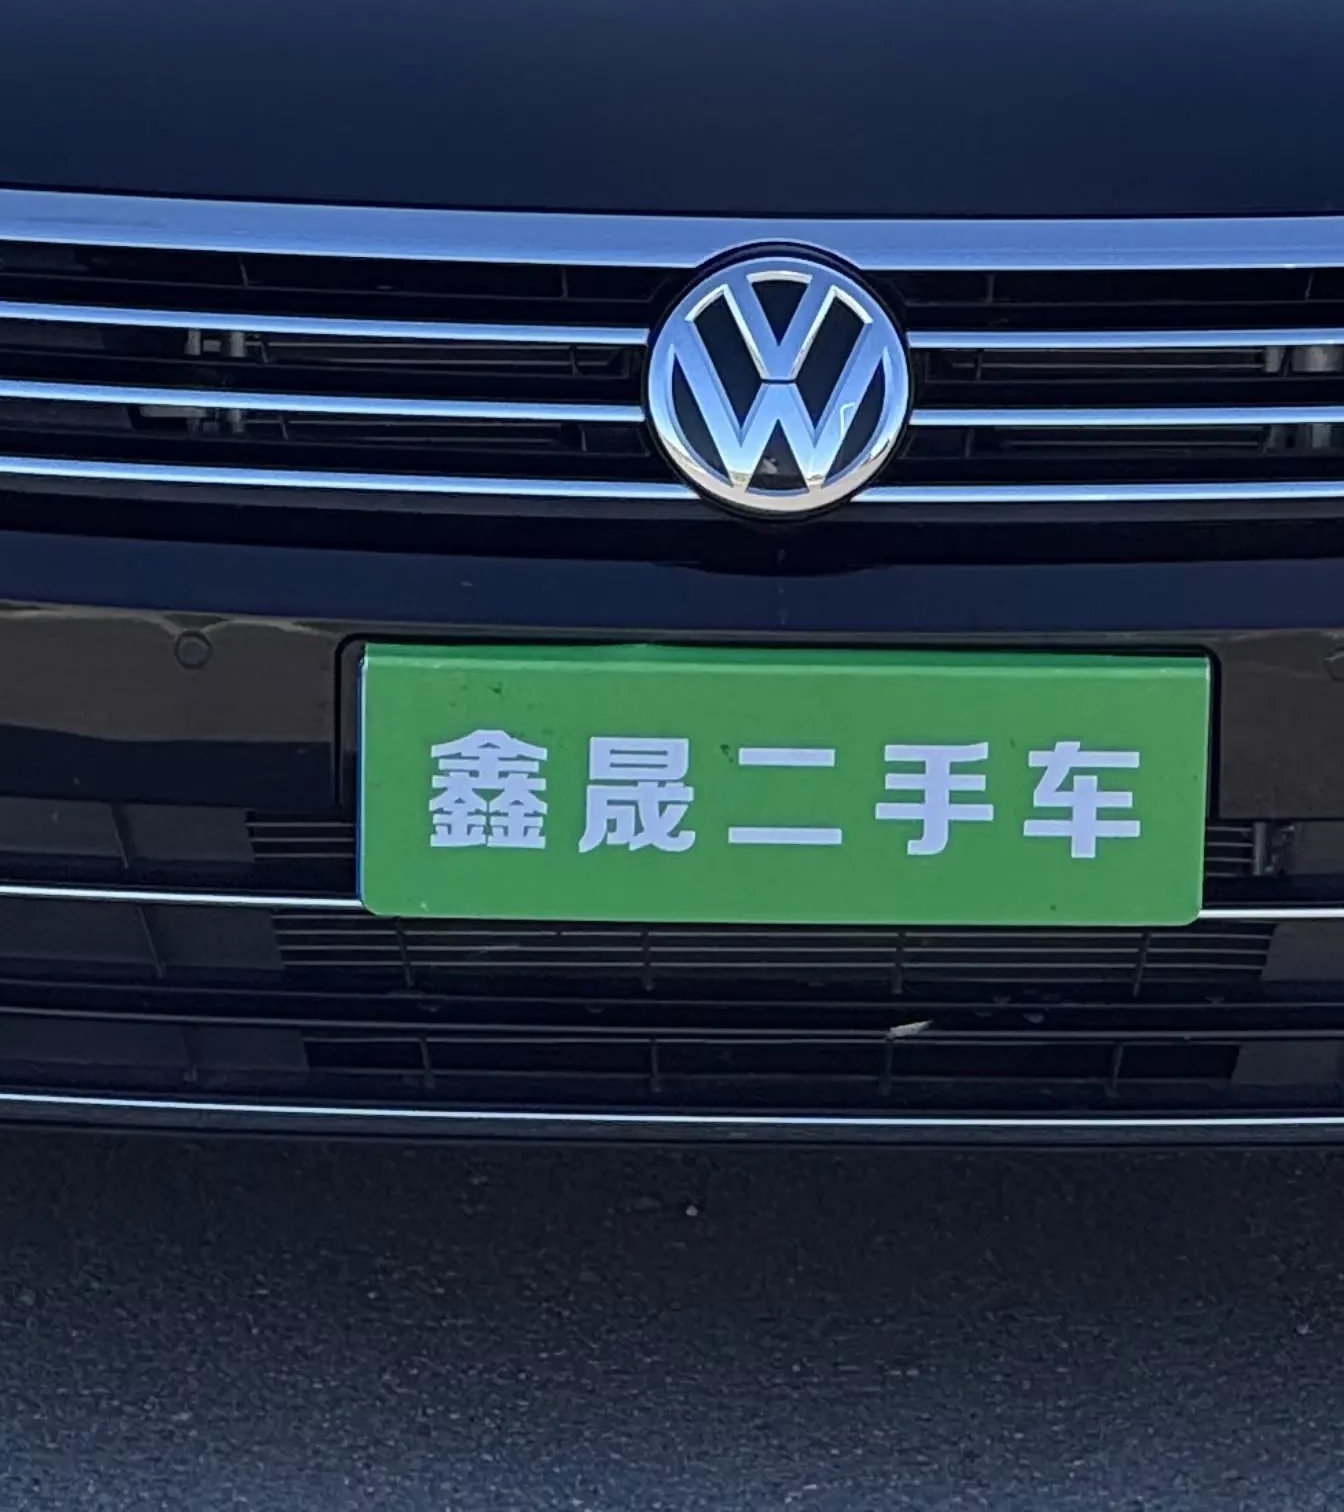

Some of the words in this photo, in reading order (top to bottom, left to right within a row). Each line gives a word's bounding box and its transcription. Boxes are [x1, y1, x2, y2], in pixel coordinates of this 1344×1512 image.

[650, 258, 907, 510] VW
[428, 728, 1142, 859] 鑫晟二手车
